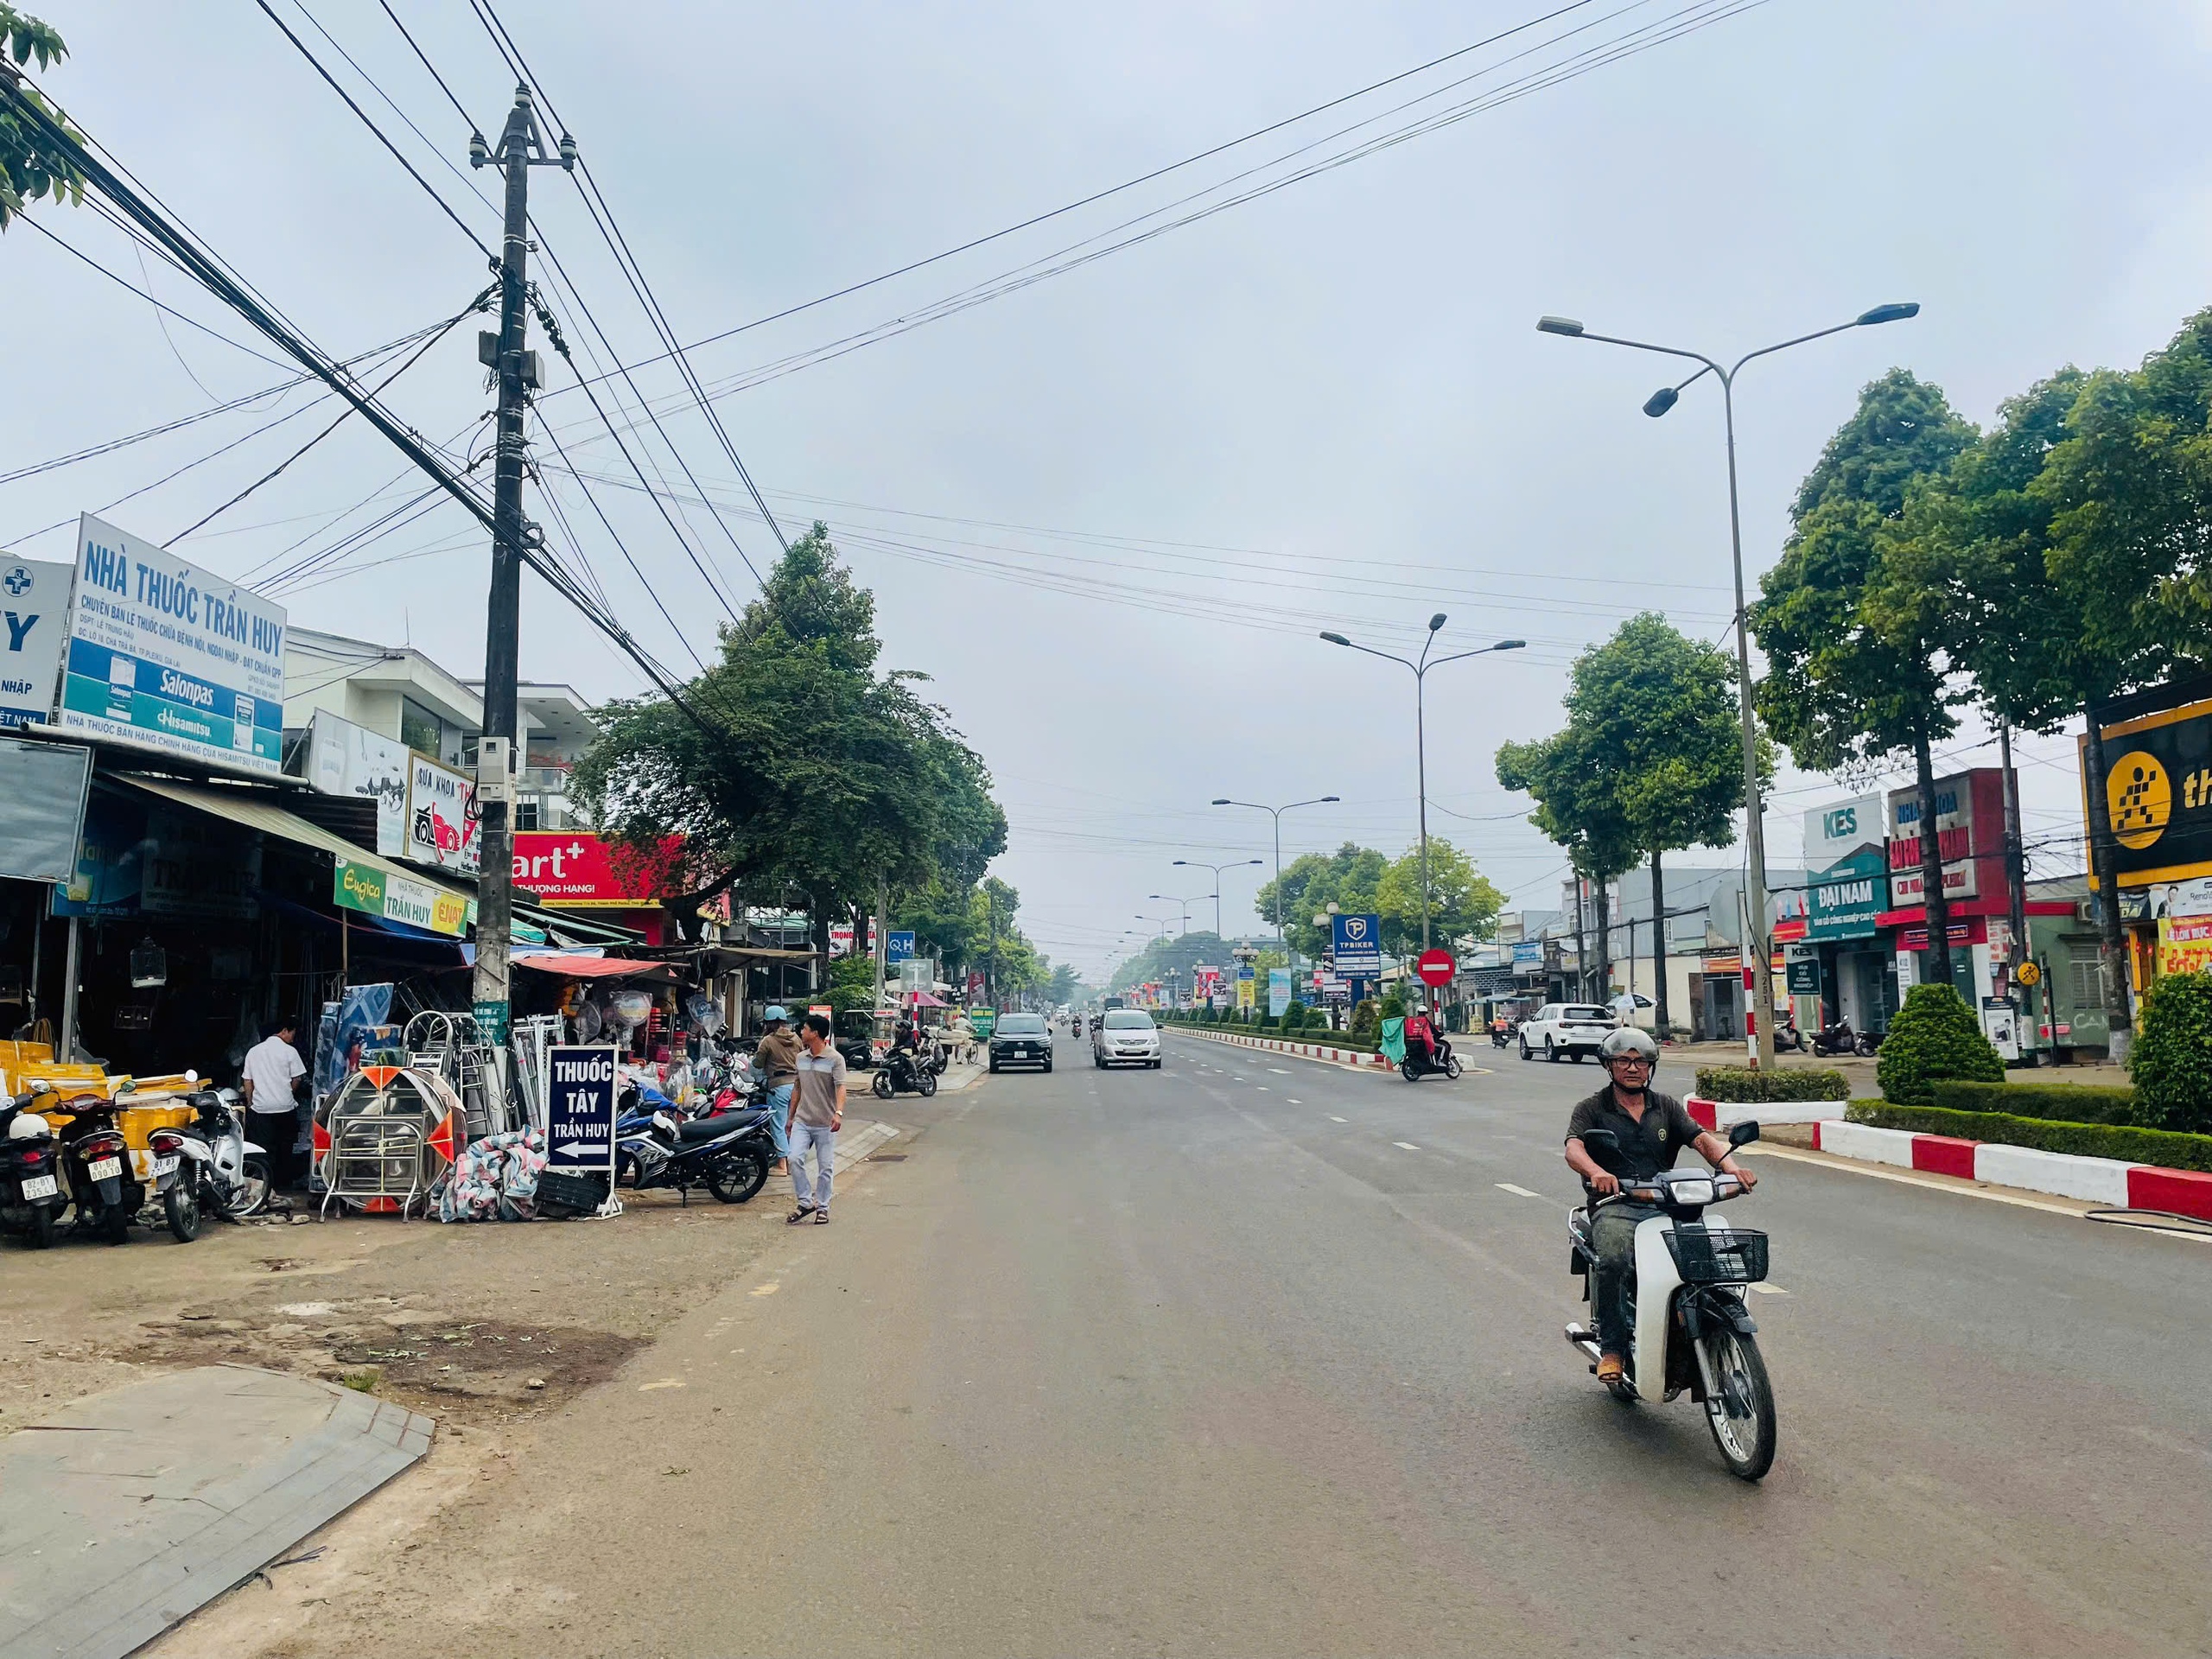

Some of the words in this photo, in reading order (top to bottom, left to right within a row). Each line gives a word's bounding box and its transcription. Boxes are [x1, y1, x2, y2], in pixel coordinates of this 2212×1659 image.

[81, 594, 110, 617] CHUYÊN
[84, 540, 127, 596] NHÀ
[137, 563, 199, 624] THUỐC
[204, 589, 247, 645] TRẦN
[252, 615, 283, 657] HUY
[0, 609, 40, 652] Y
[1, 679, 33, 696] NHẬP
[160, 669, 214, 706] Salonpas
[157, 708, 211, 737] Hisamitsu
[218, 751, 251, 766] HISAMITSU
[1823, 808, 1857, 839] KES
[343, 868, 380, 901] Eugica
[563, 884, 595, 894] HẠNG!
[1818, 885, 1840, 912] ĐẠI
[1840, 880, 1873, 905] NAM
[386, 894, 411, 919] TRẦN
[412, 904, 431, 924] HUY
[555, 1054, 613, 1083] THUỐC
[566, 1089, 599, 1113] TÂY
[554, 1117, 583, 1138] TRẦN
[586, 1123, 610, 1138] HUY
